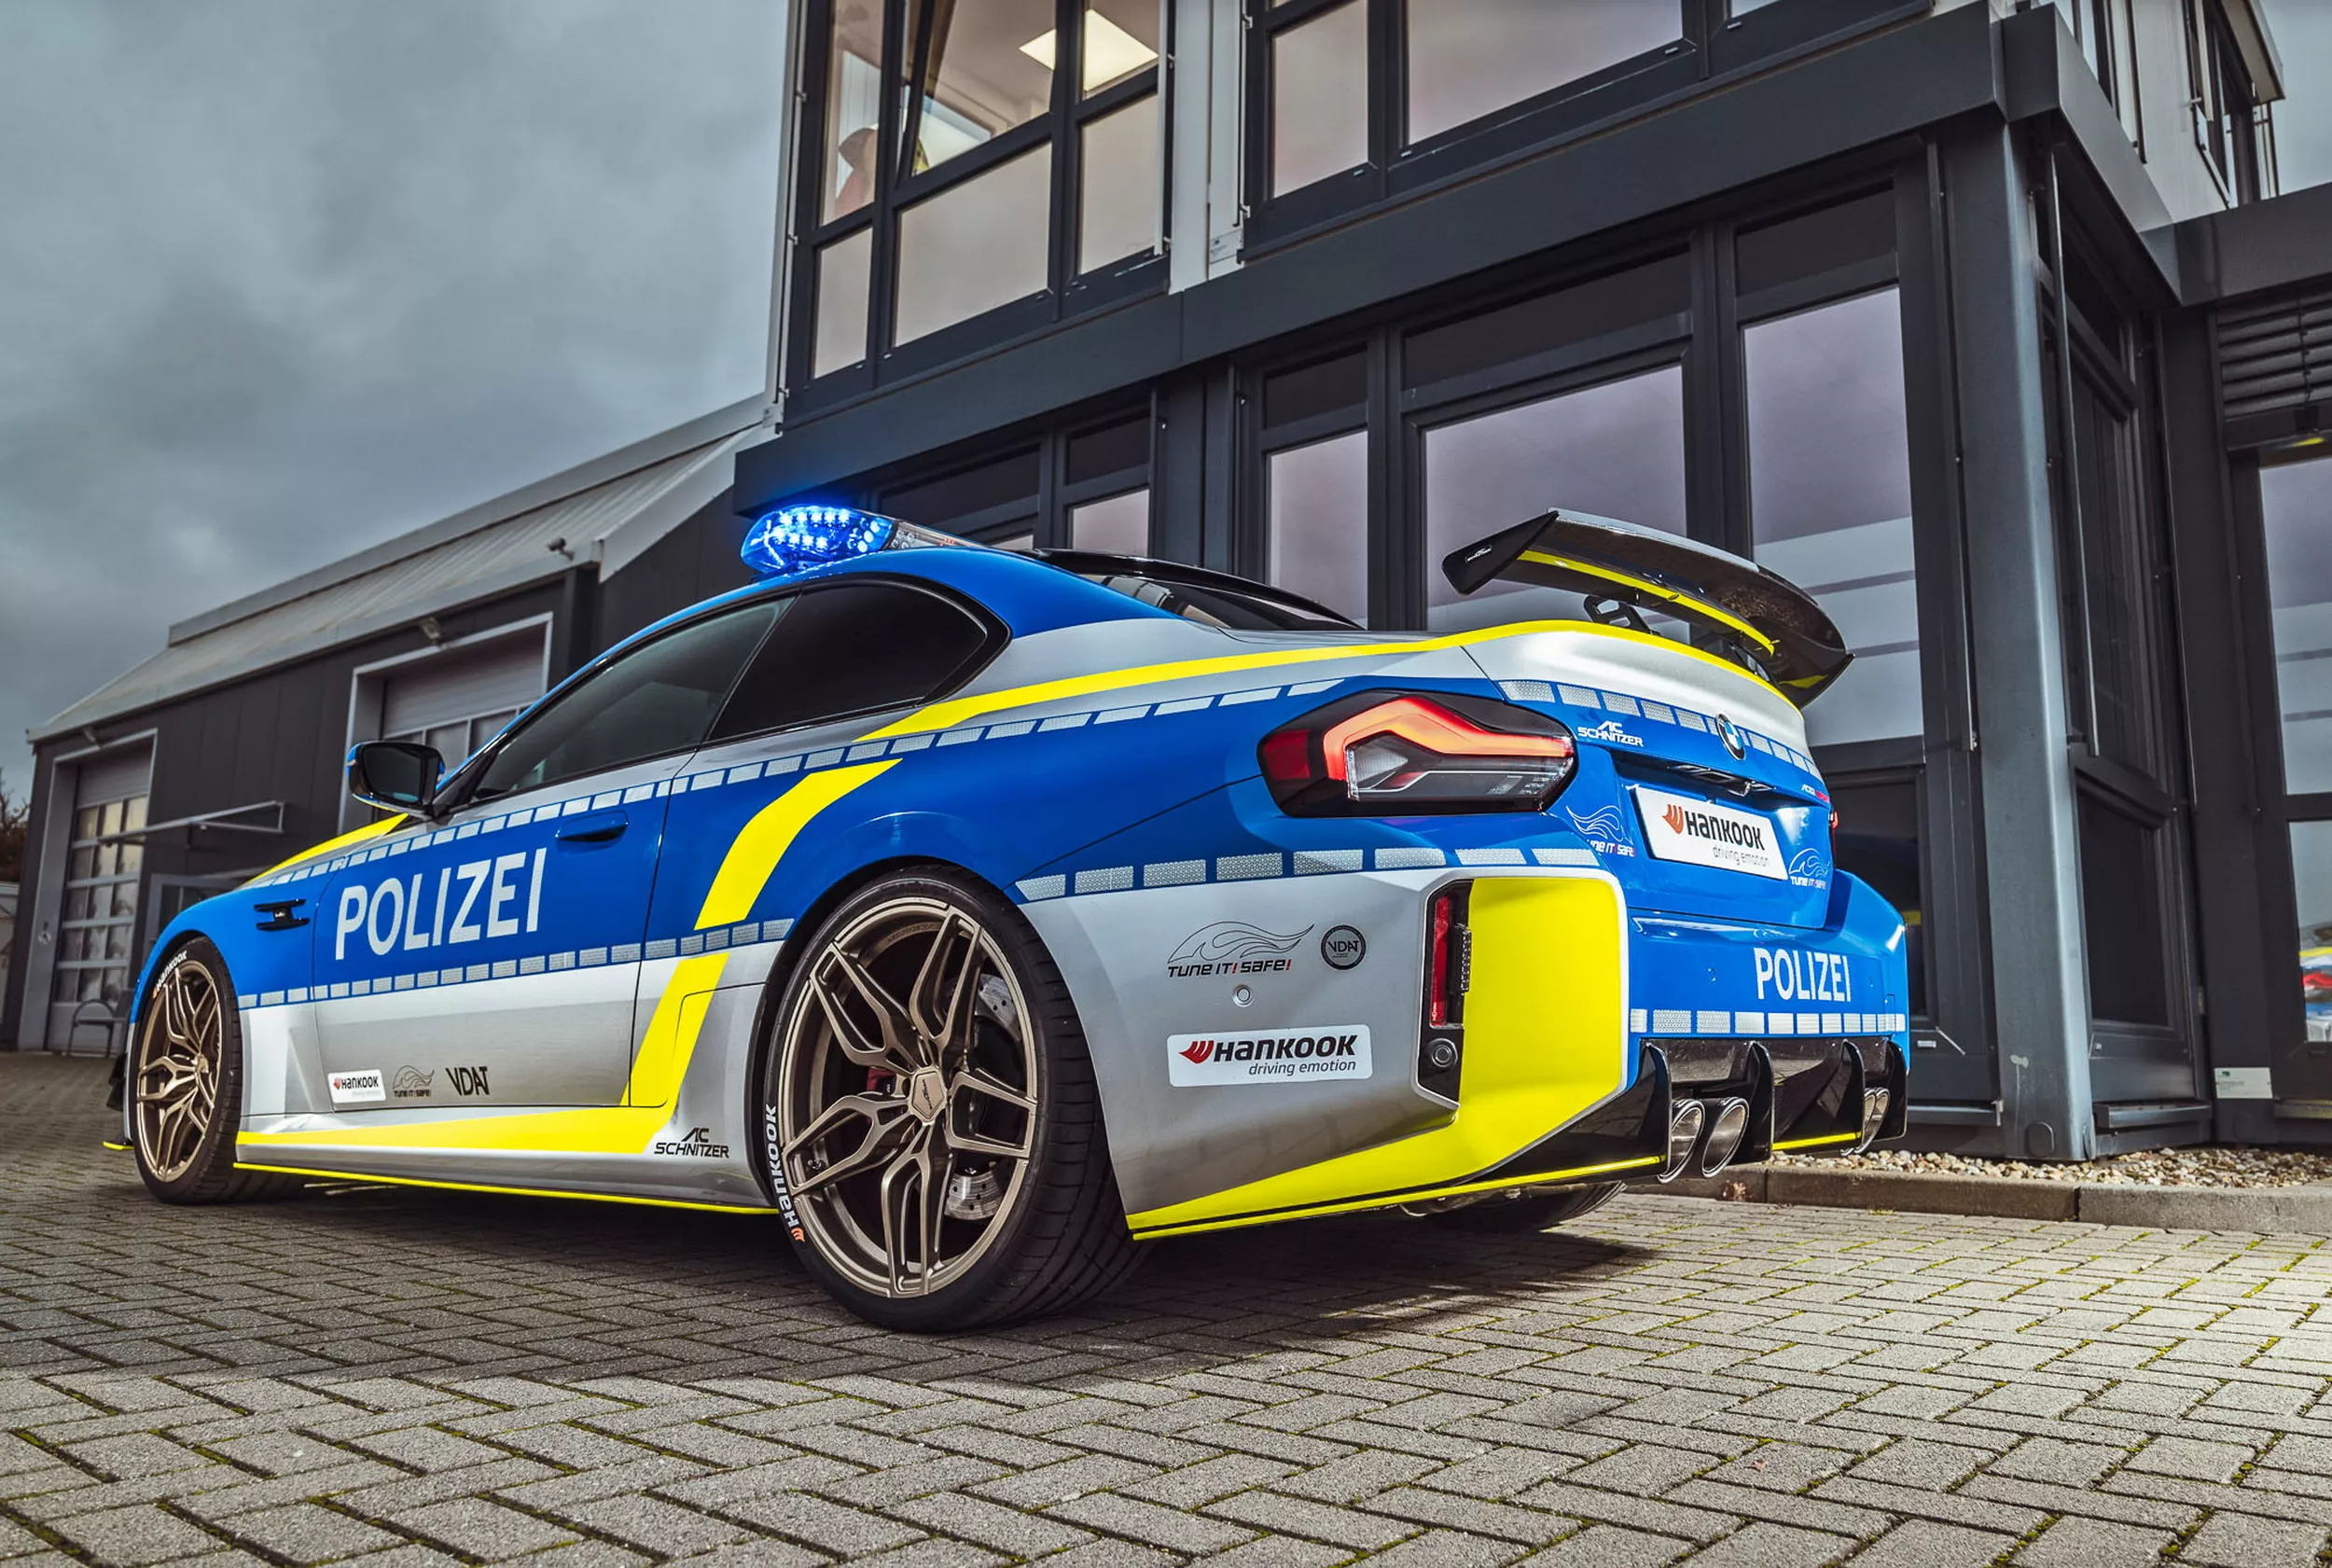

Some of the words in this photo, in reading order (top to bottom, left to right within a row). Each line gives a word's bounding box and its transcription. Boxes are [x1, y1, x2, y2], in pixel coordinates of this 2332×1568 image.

[1598, 720, 1623, 734] AC
[1577, 727, 1644, 747] SCHNITZER
[335, 847, 548, 961] POLIZEI
[1215, 963, 1238, 975] IT!
[1754, 948, 1852, 1003] POLIZEI
[1248, 1062, 1296, 1076] driving
[1299, 1060, 1356, 1074] emotion
[445, 1066, 490, 1096] VDAT
[681, 1127, 709, 1143] AC
[654, 1143, 729, 1159] SCHNITZER
